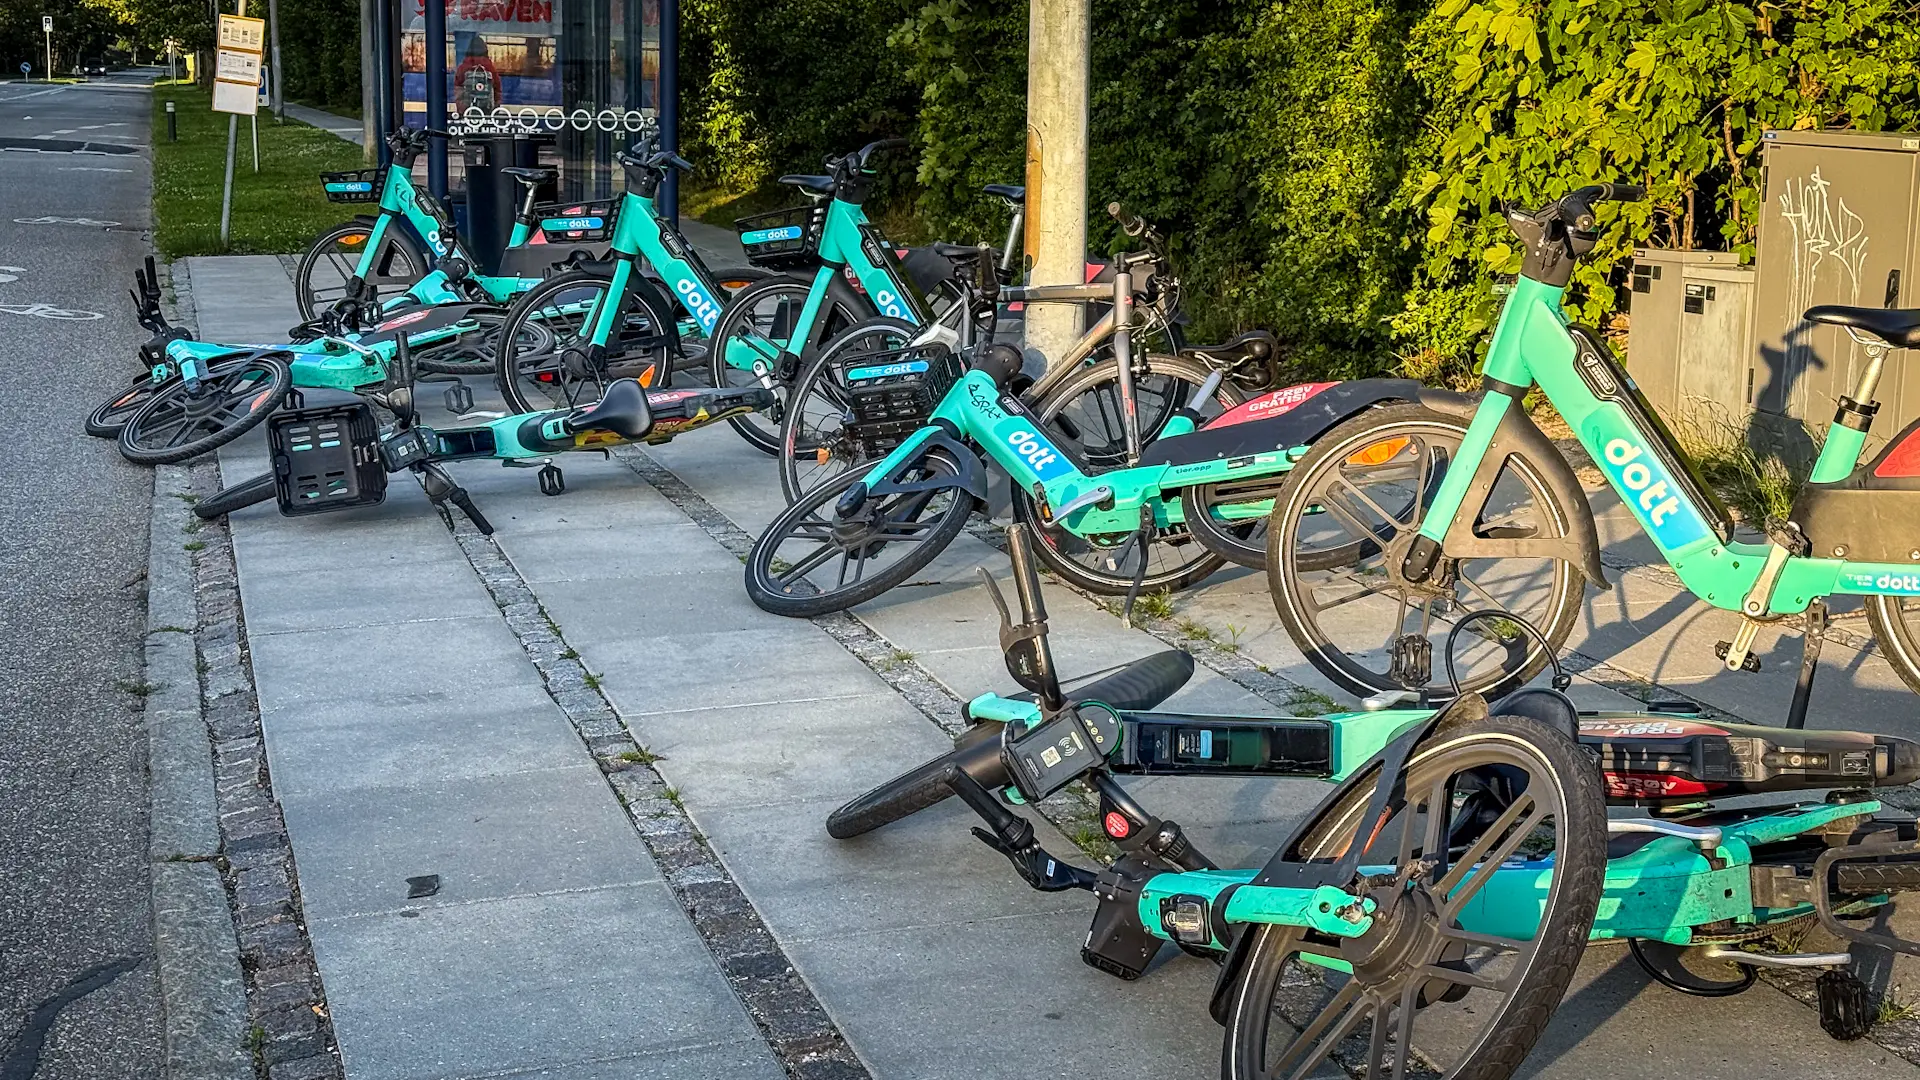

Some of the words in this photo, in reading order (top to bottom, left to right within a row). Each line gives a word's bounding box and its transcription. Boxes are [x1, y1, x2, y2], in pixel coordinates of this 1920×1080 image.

[569, 218, 592, 228] dott
[767, 228, 789, 239] dott
[677, 278, 719, 327] dott
[884, 360, 912, 374] dott
[1008, 430, 1057, 471] dott
[1604, 438, 1682, 527] dott
[1876, 574, 1920, 591] dott
